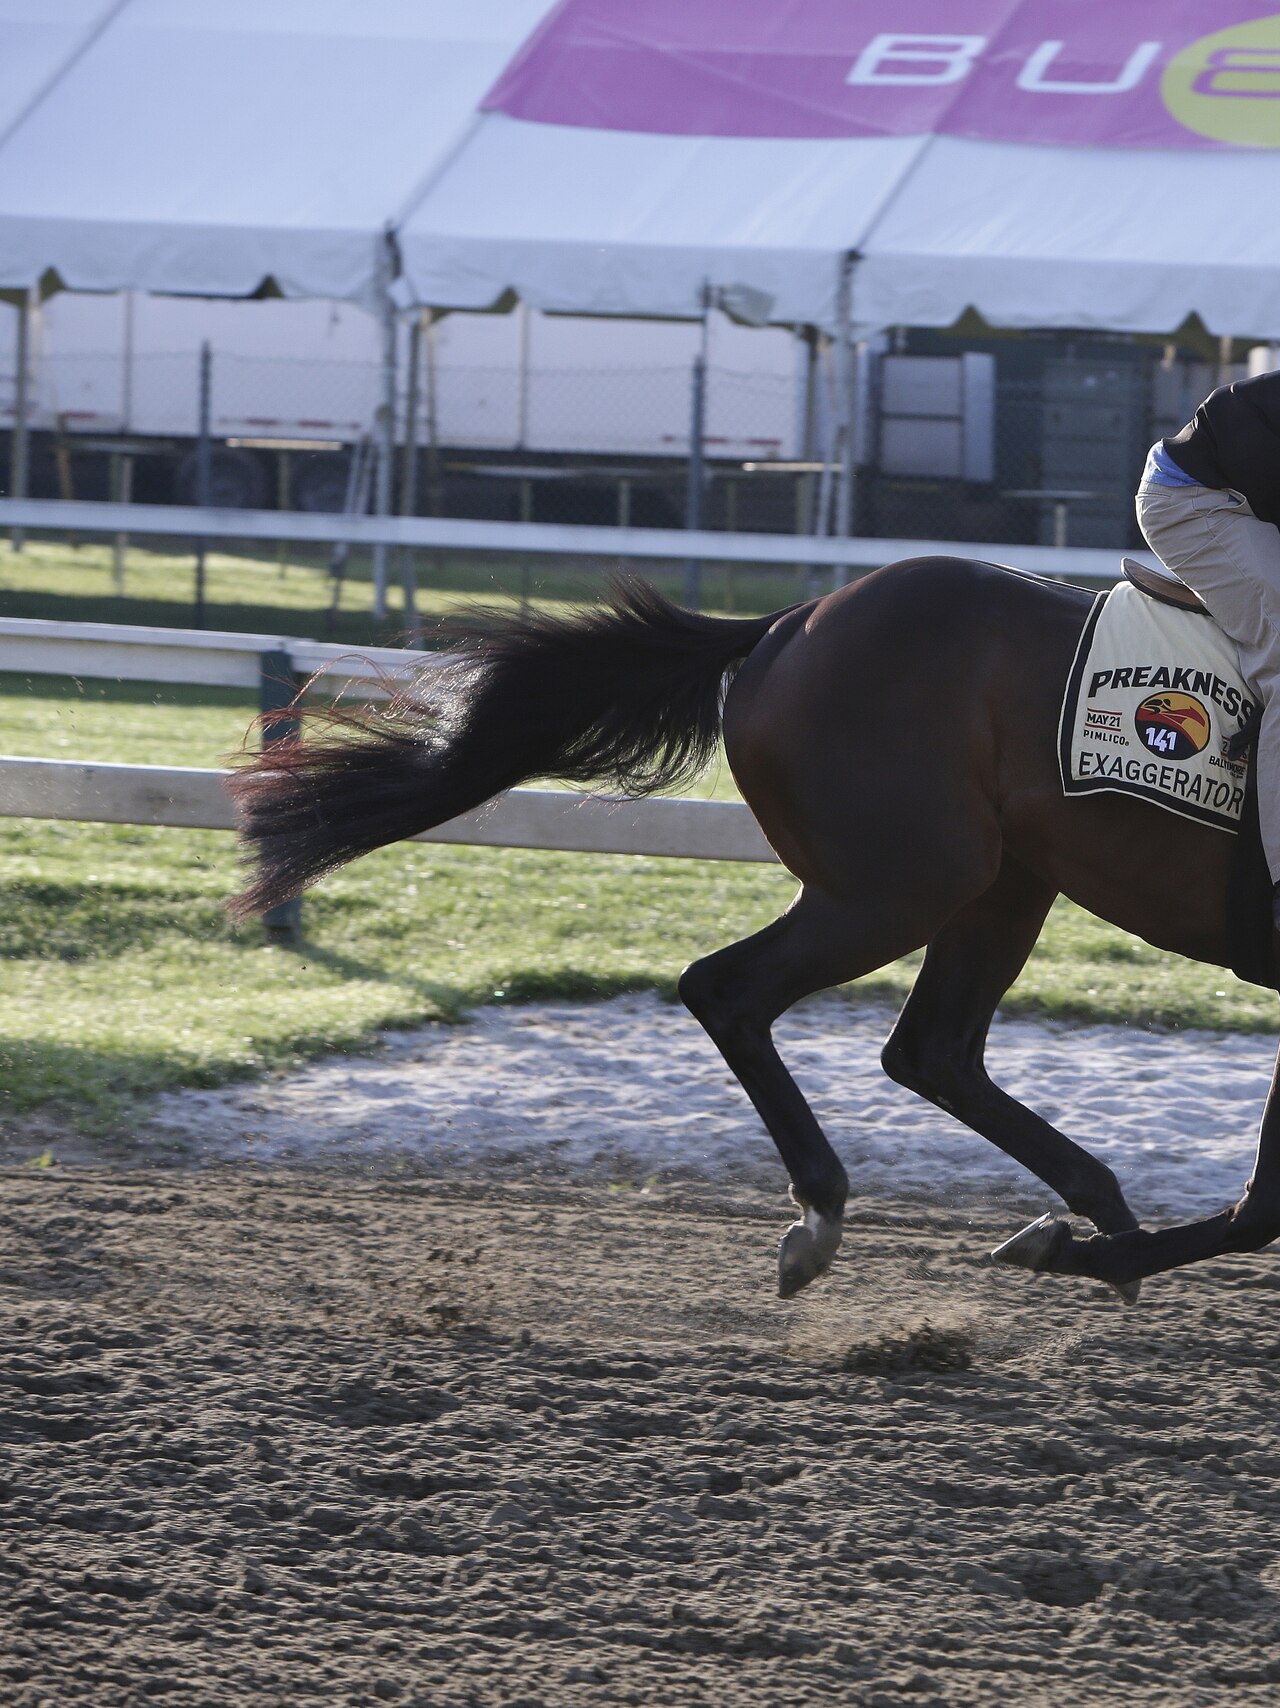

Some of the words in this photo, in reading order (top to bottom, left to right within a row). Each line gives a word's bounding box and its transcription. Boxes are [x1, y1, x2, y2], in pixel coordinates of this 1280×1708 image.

[1087, 666, 1256, 730] PREAKNESS
[1086, 712, 1109, 725] MAY
[1109, 716, 1121, 728] 21
[1145, 727, 1177, 752] 141
[1208, 755, 1246, 776] BALTIMORE
[1078, 751, 1244, 815] EXAGGERATOR
